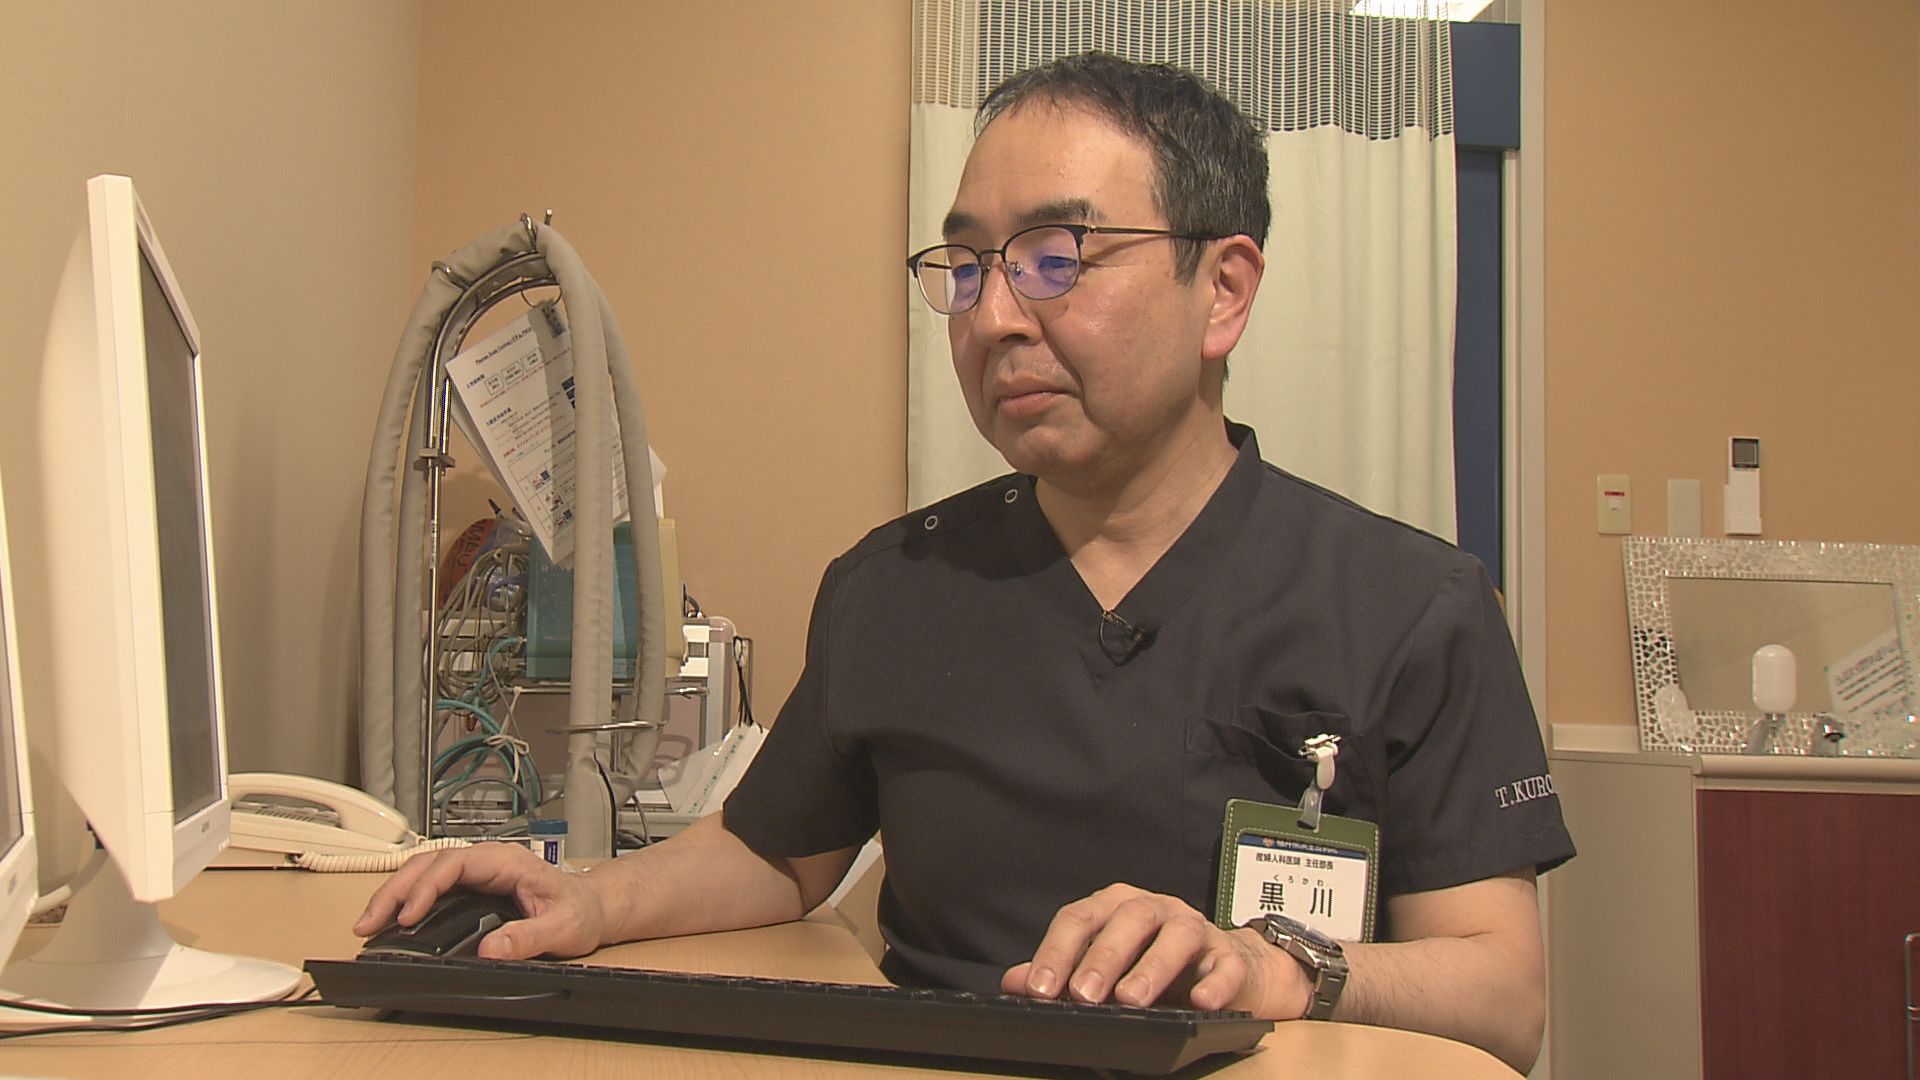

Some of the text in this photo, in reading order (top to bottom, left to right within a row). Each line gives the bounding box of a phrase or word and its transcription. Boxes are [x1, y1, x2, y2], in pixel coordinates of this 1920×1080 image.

[1495, 774, 1558, 808] T.KURO
[1255, 852, 1334, 871] 産婦人科医師 主任部長
[1273, 874, 1324, 887] くろかわ
[1258, 881, 1333, 918] 黒川
